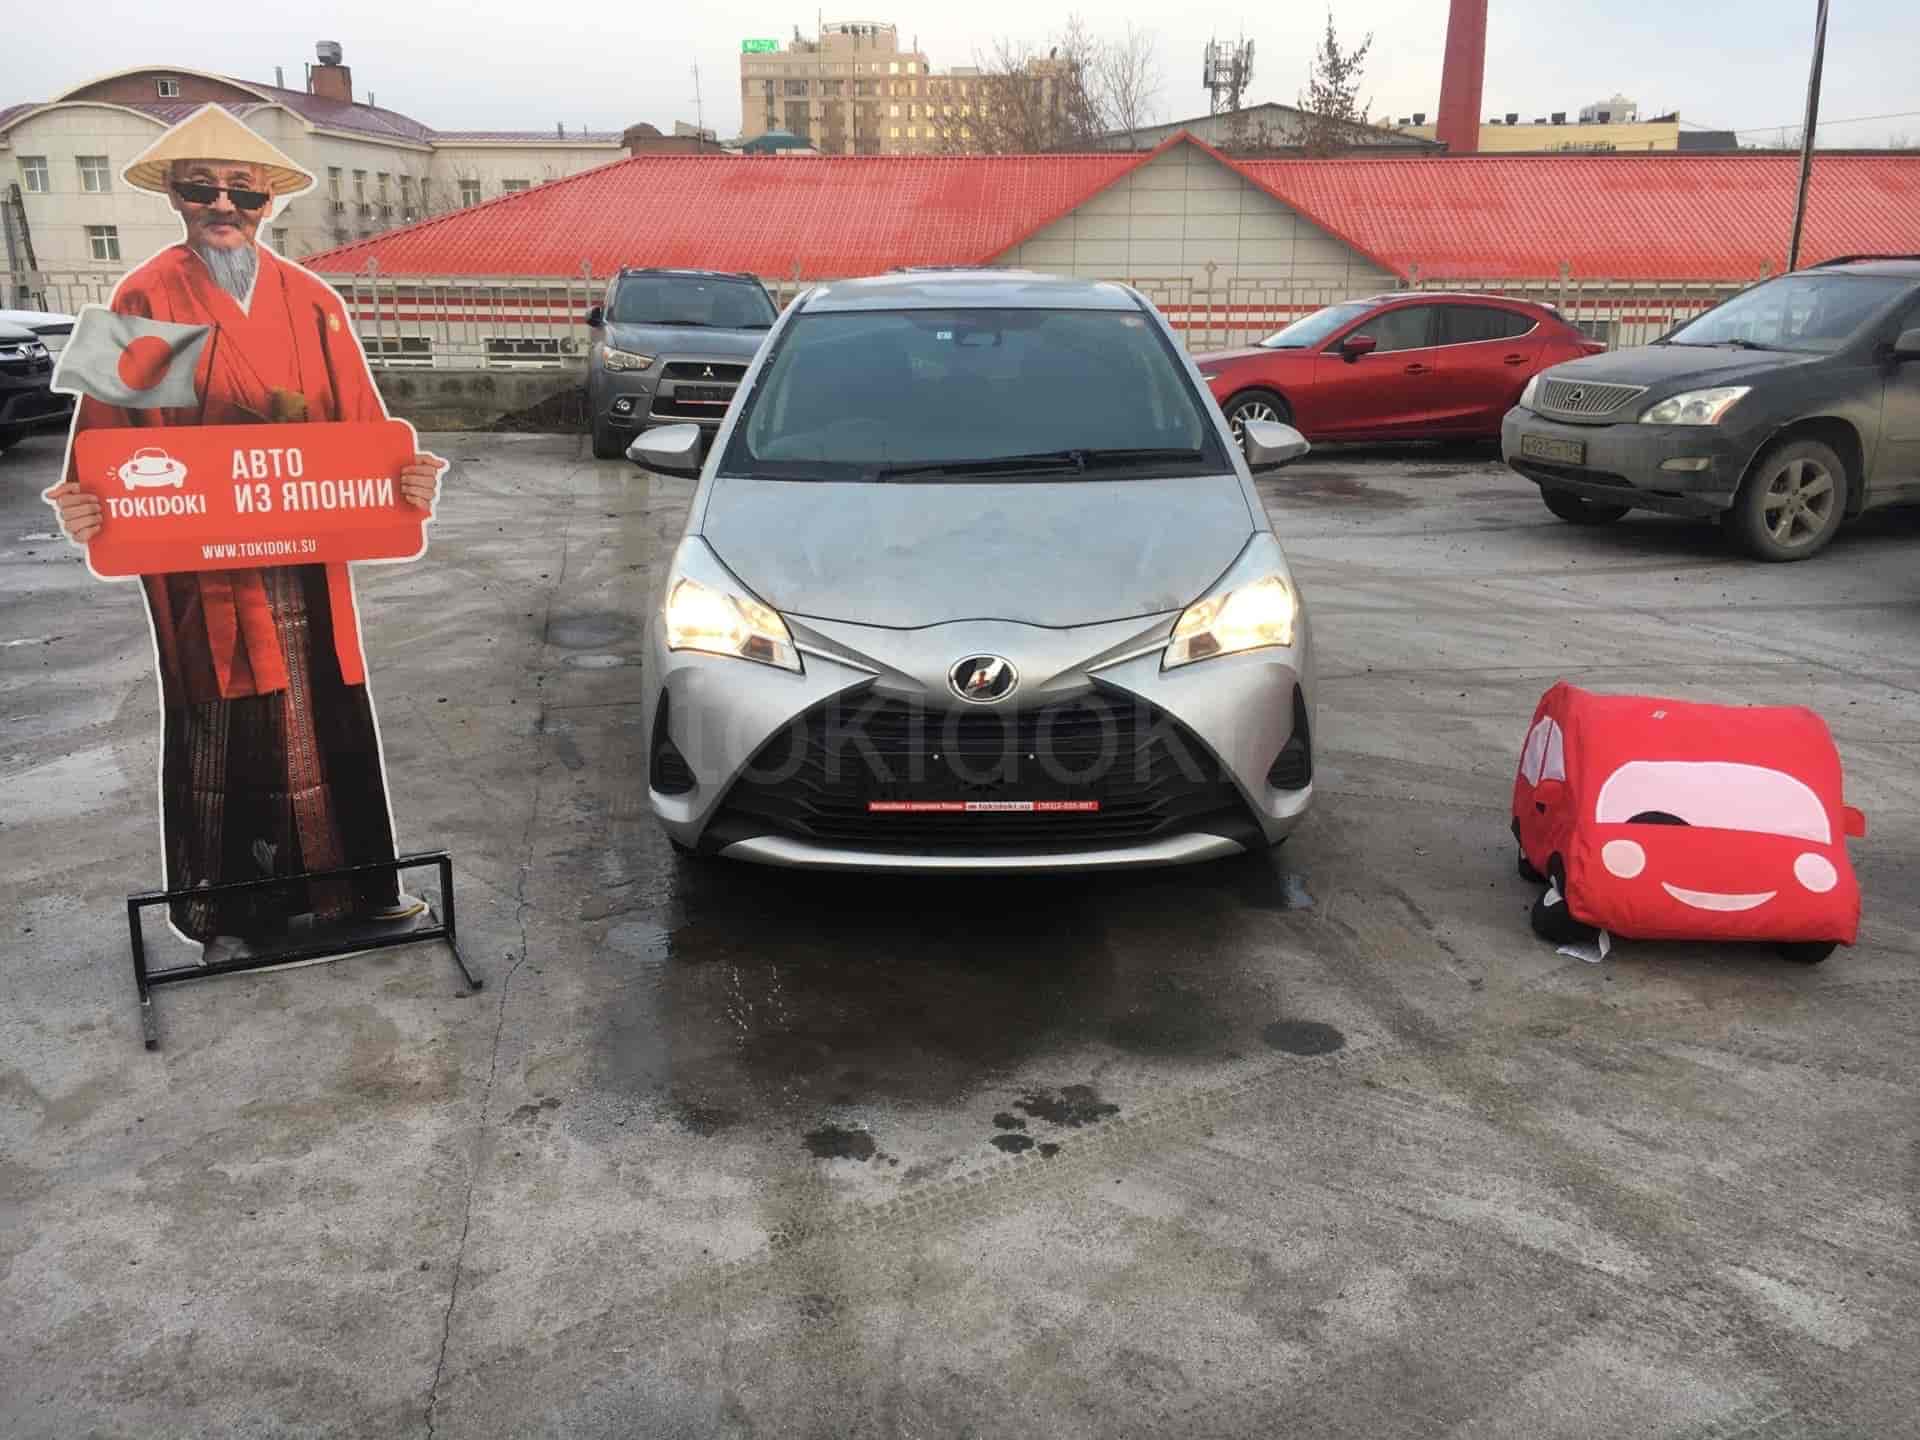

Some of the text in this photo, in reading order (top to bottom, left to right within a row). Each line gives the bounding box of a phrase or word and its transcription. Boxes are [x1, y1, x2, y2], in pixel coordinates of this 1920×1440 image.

[231, 447, 304, 479] АВТО
[106, 494, 207, 518] TOKIDOKI
[234, 478, 394, 513] ИЗ ЯПОНИИ
[202, 539, 316, 559] WWW.TOKIDOKI.SU
